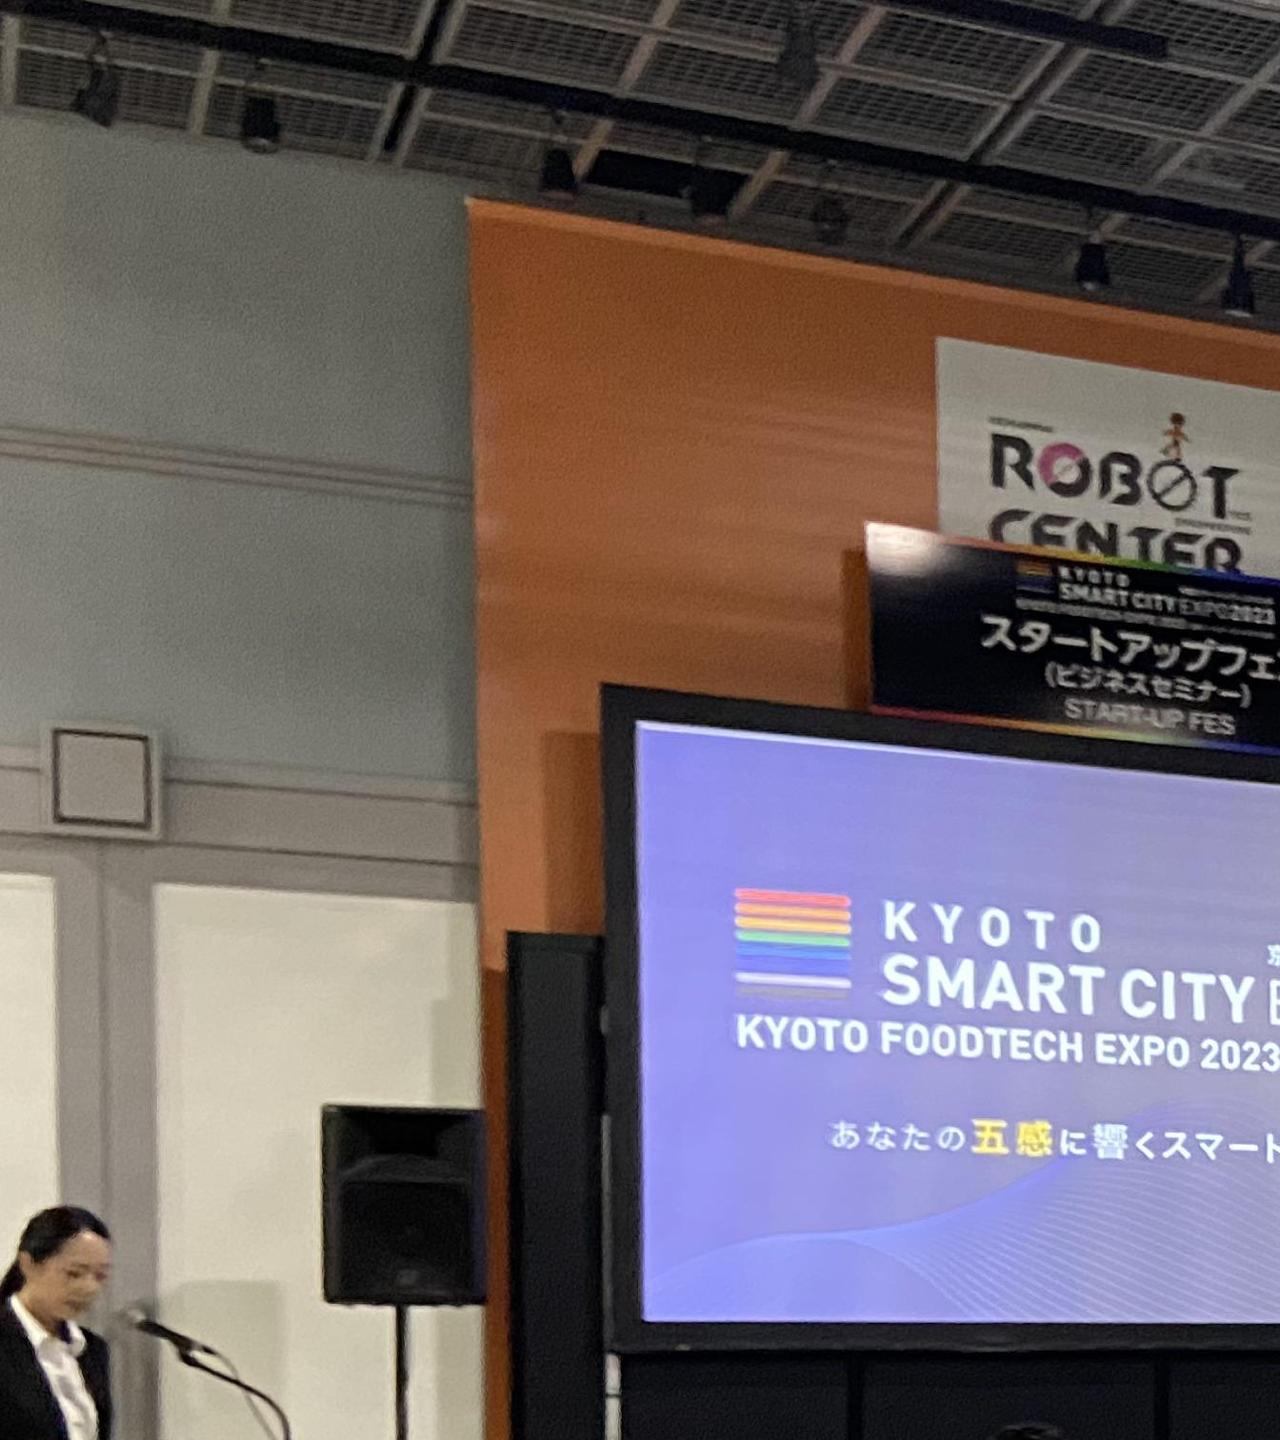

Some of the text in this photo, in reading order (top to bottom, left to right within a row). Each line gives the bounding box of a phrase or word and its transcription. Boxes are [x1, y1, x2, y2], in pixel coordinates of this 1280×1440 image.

[990, 433, 1240, 519] ROBOT
[1189, 711, 1236, 735] FES
[882, 900, 1101, 954] KYOTO
[881, 953, 1105, 1016] SMART
[1120, 968, 1255, 1024] CITY
[736, 1015, 869, 1053] KYOTO
[880, 1021, 1084, 1064] FOODTECH
[1095, 1034, 1190, 1068] EXPO
